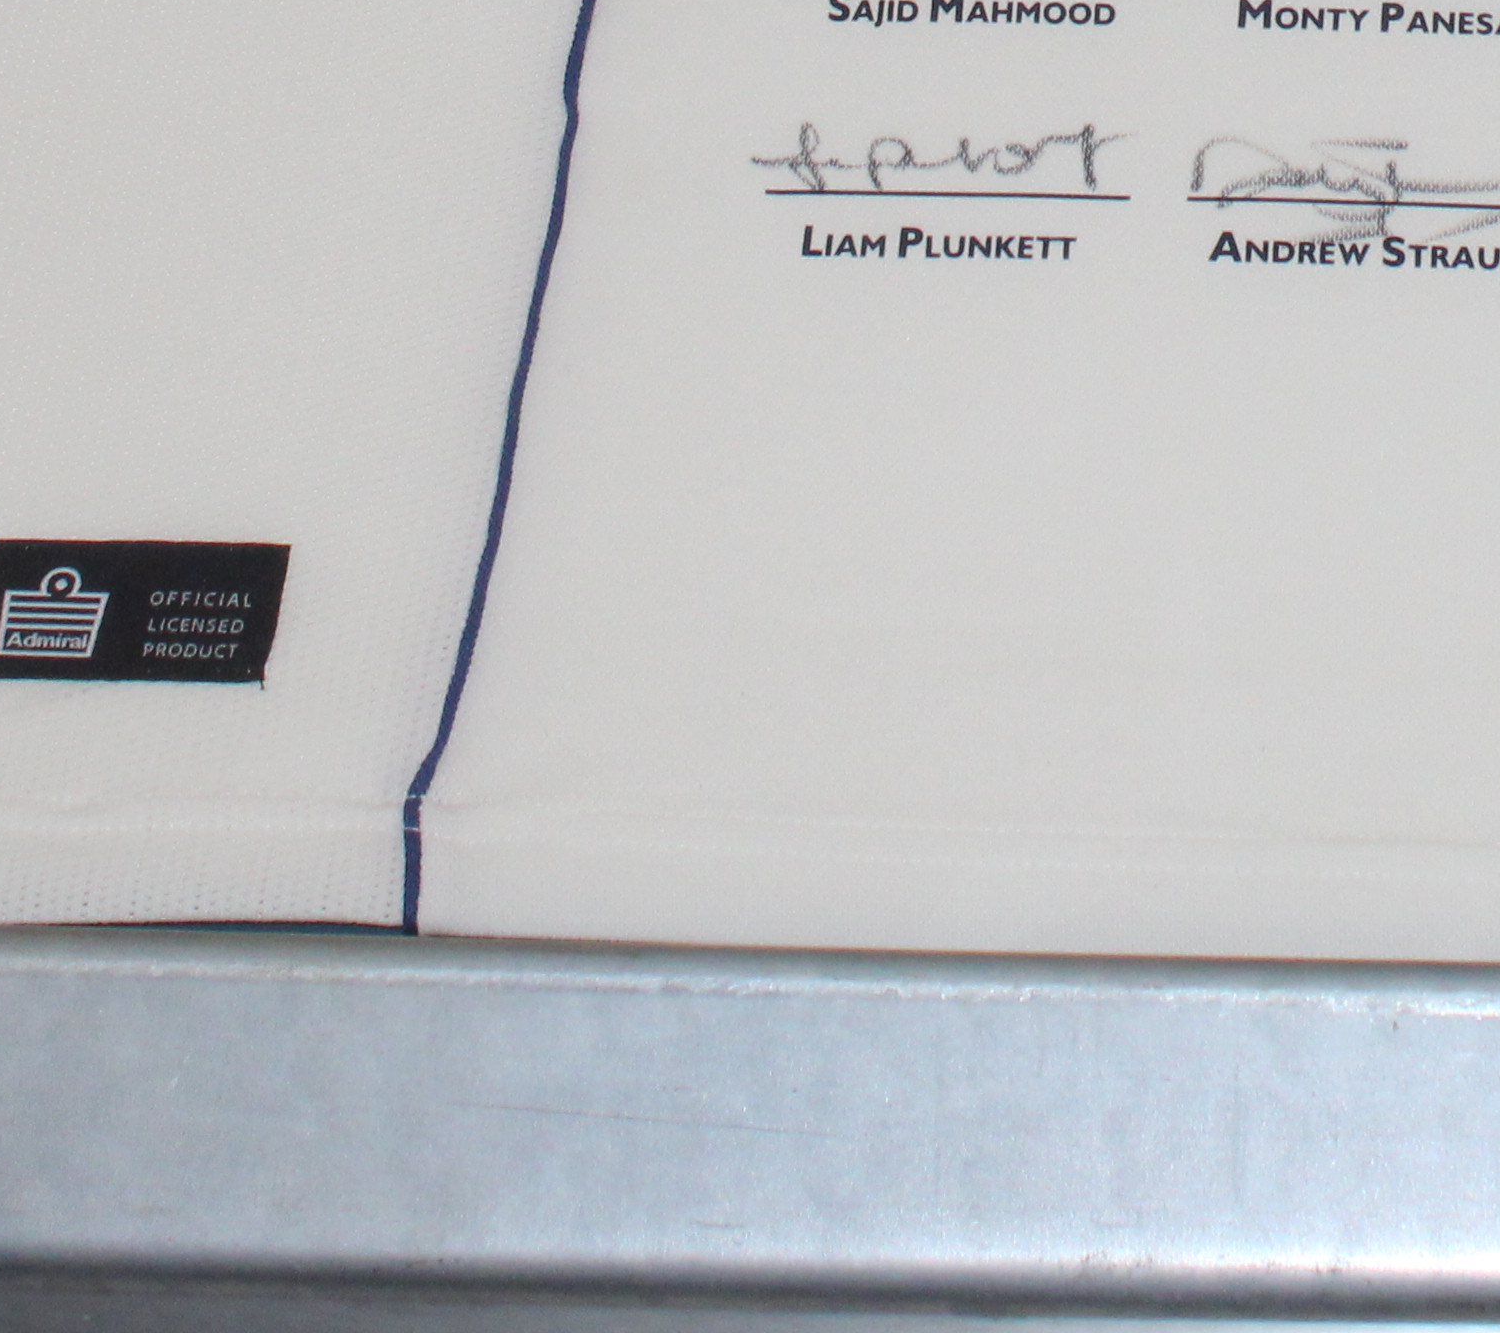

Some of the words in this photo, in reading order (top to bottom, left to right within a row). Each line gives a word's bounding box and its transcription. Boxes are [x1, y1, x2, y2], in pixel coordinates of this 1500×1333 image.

[801, 226, 886, 257] LIAM
[898, 227, 1075, 259] PLUNKETT
[1209, 232, 1370, 265] ANDREW
[149, 590, 252, 609] OFFICIAL
[147, 617, 245, 635] LICENSED
[5, 631, 88, 649] Admiral
[142, 642, 239, 660] PRODUCT
